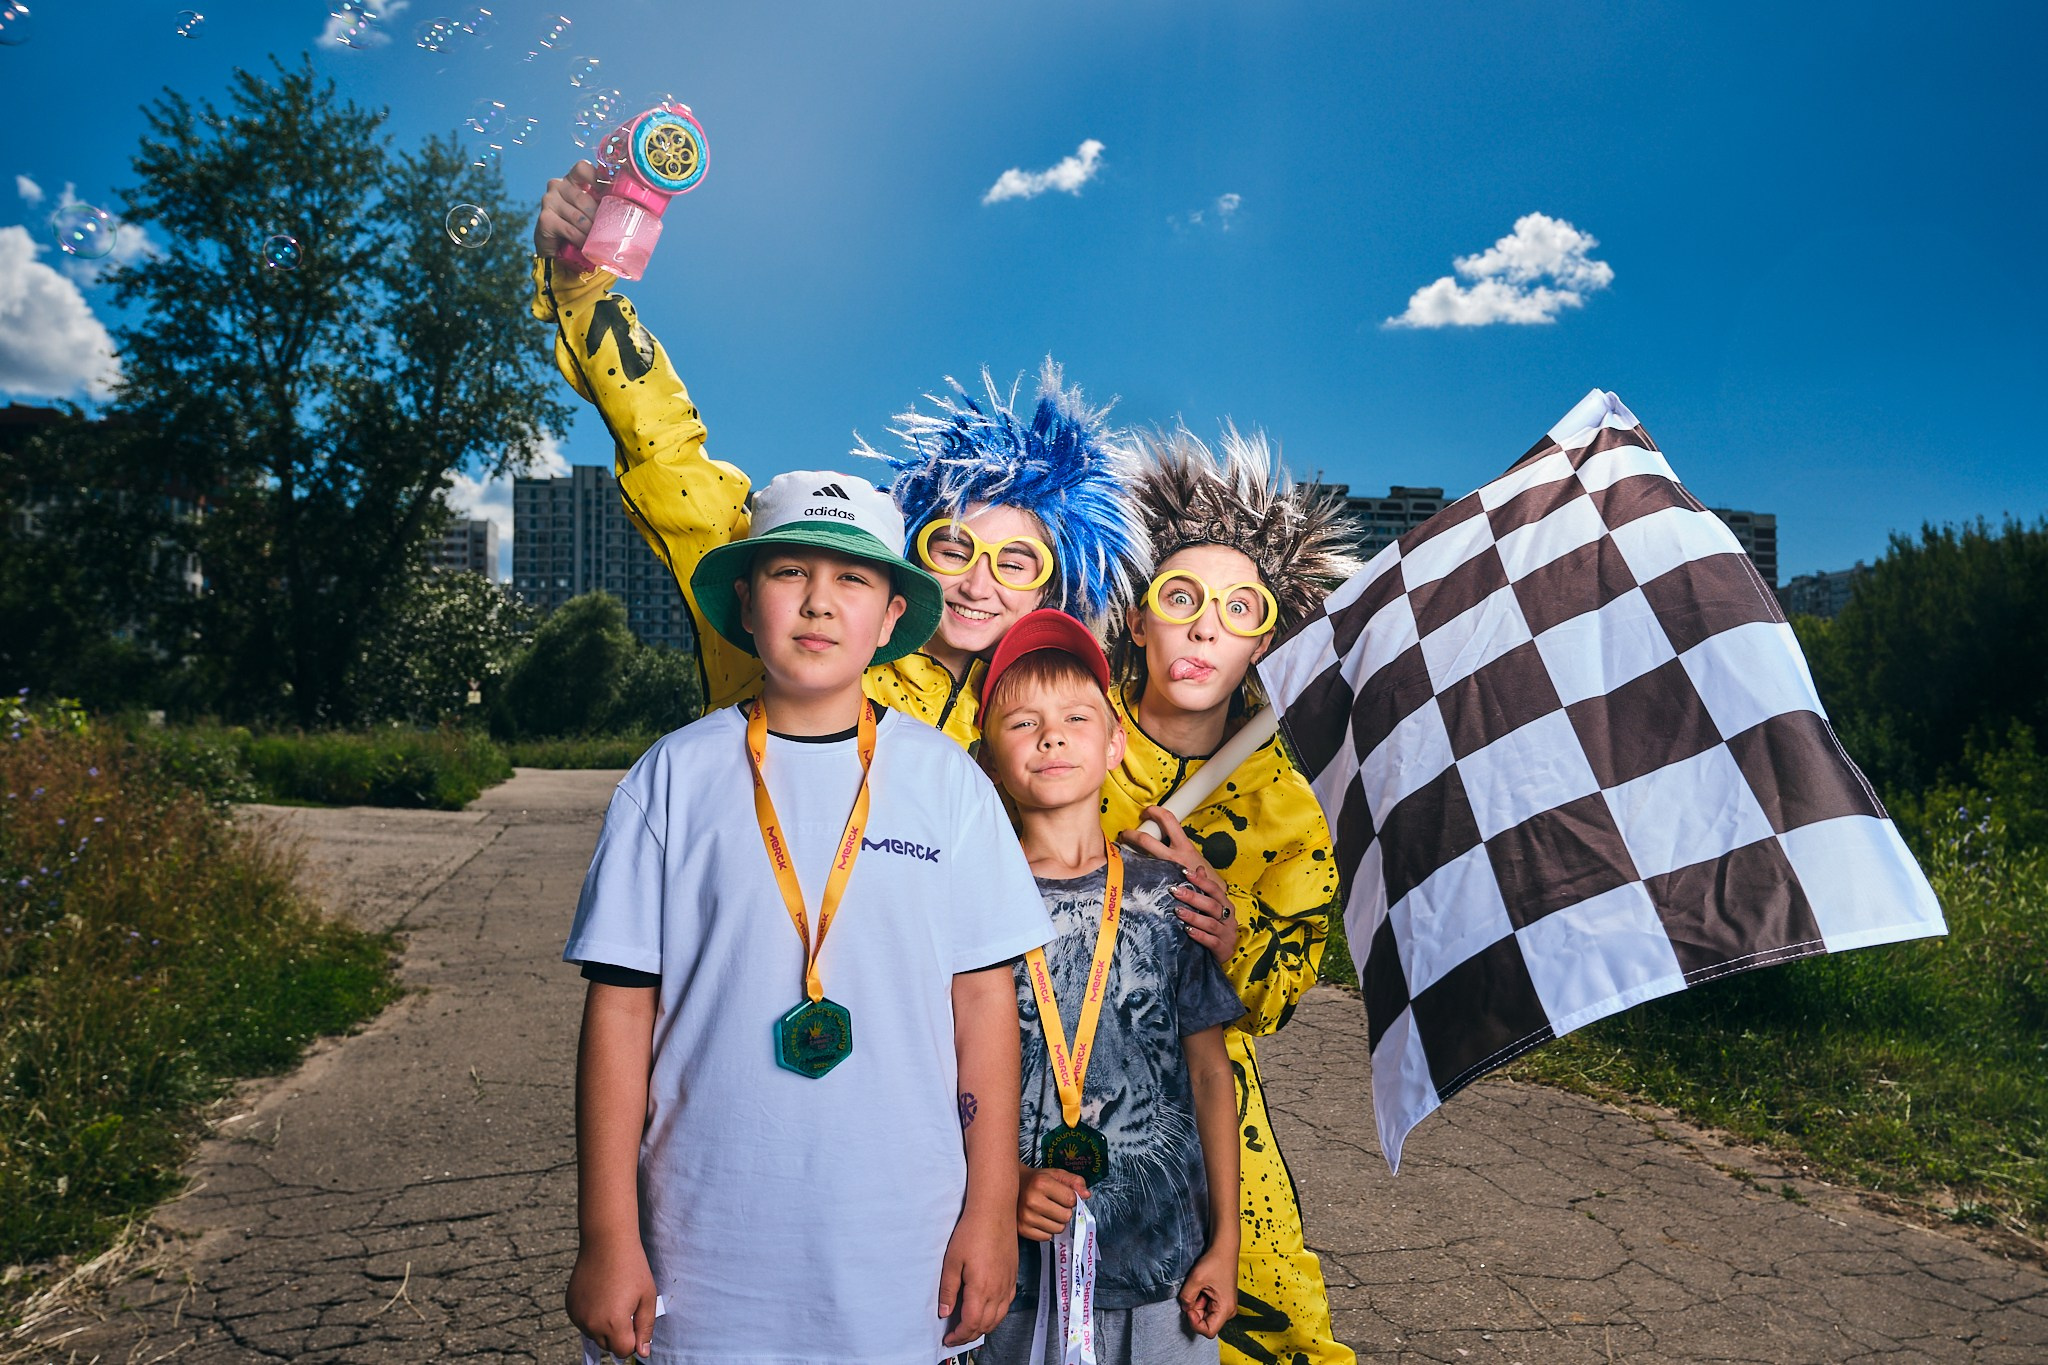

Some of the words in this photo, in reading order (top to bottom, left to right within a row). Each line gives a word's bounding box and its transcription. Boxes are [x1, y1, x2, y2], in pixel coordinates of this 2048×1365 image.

[804, 506, 855, 521] adidas
[1060, 1267, 1069, 1312] CHARITY
[1083, 1281, 1092, 1327] CHARITY
[1083, 1331, 1091, 1353] DAY
